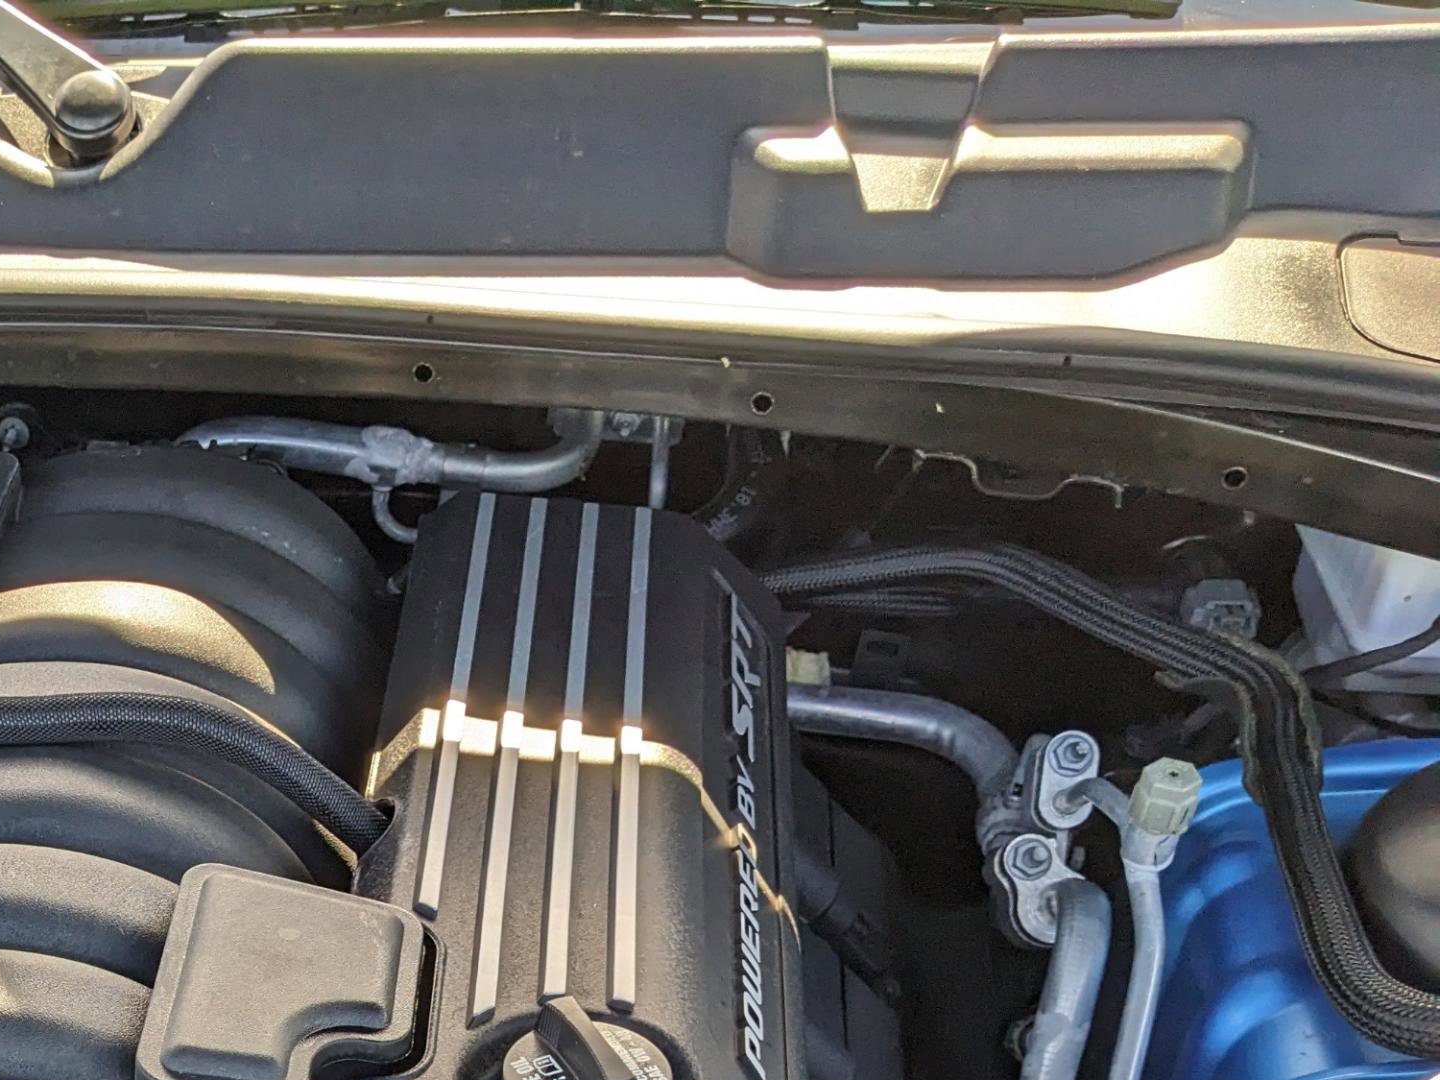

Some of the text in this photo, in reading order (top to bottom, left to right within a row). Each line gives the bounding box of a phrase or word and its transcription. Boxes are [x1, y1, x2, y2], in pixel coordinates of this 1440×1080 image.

[731, 592, 766, 1080] POWERED BY SRT
[510, 1056, 534, 1075] OIL
